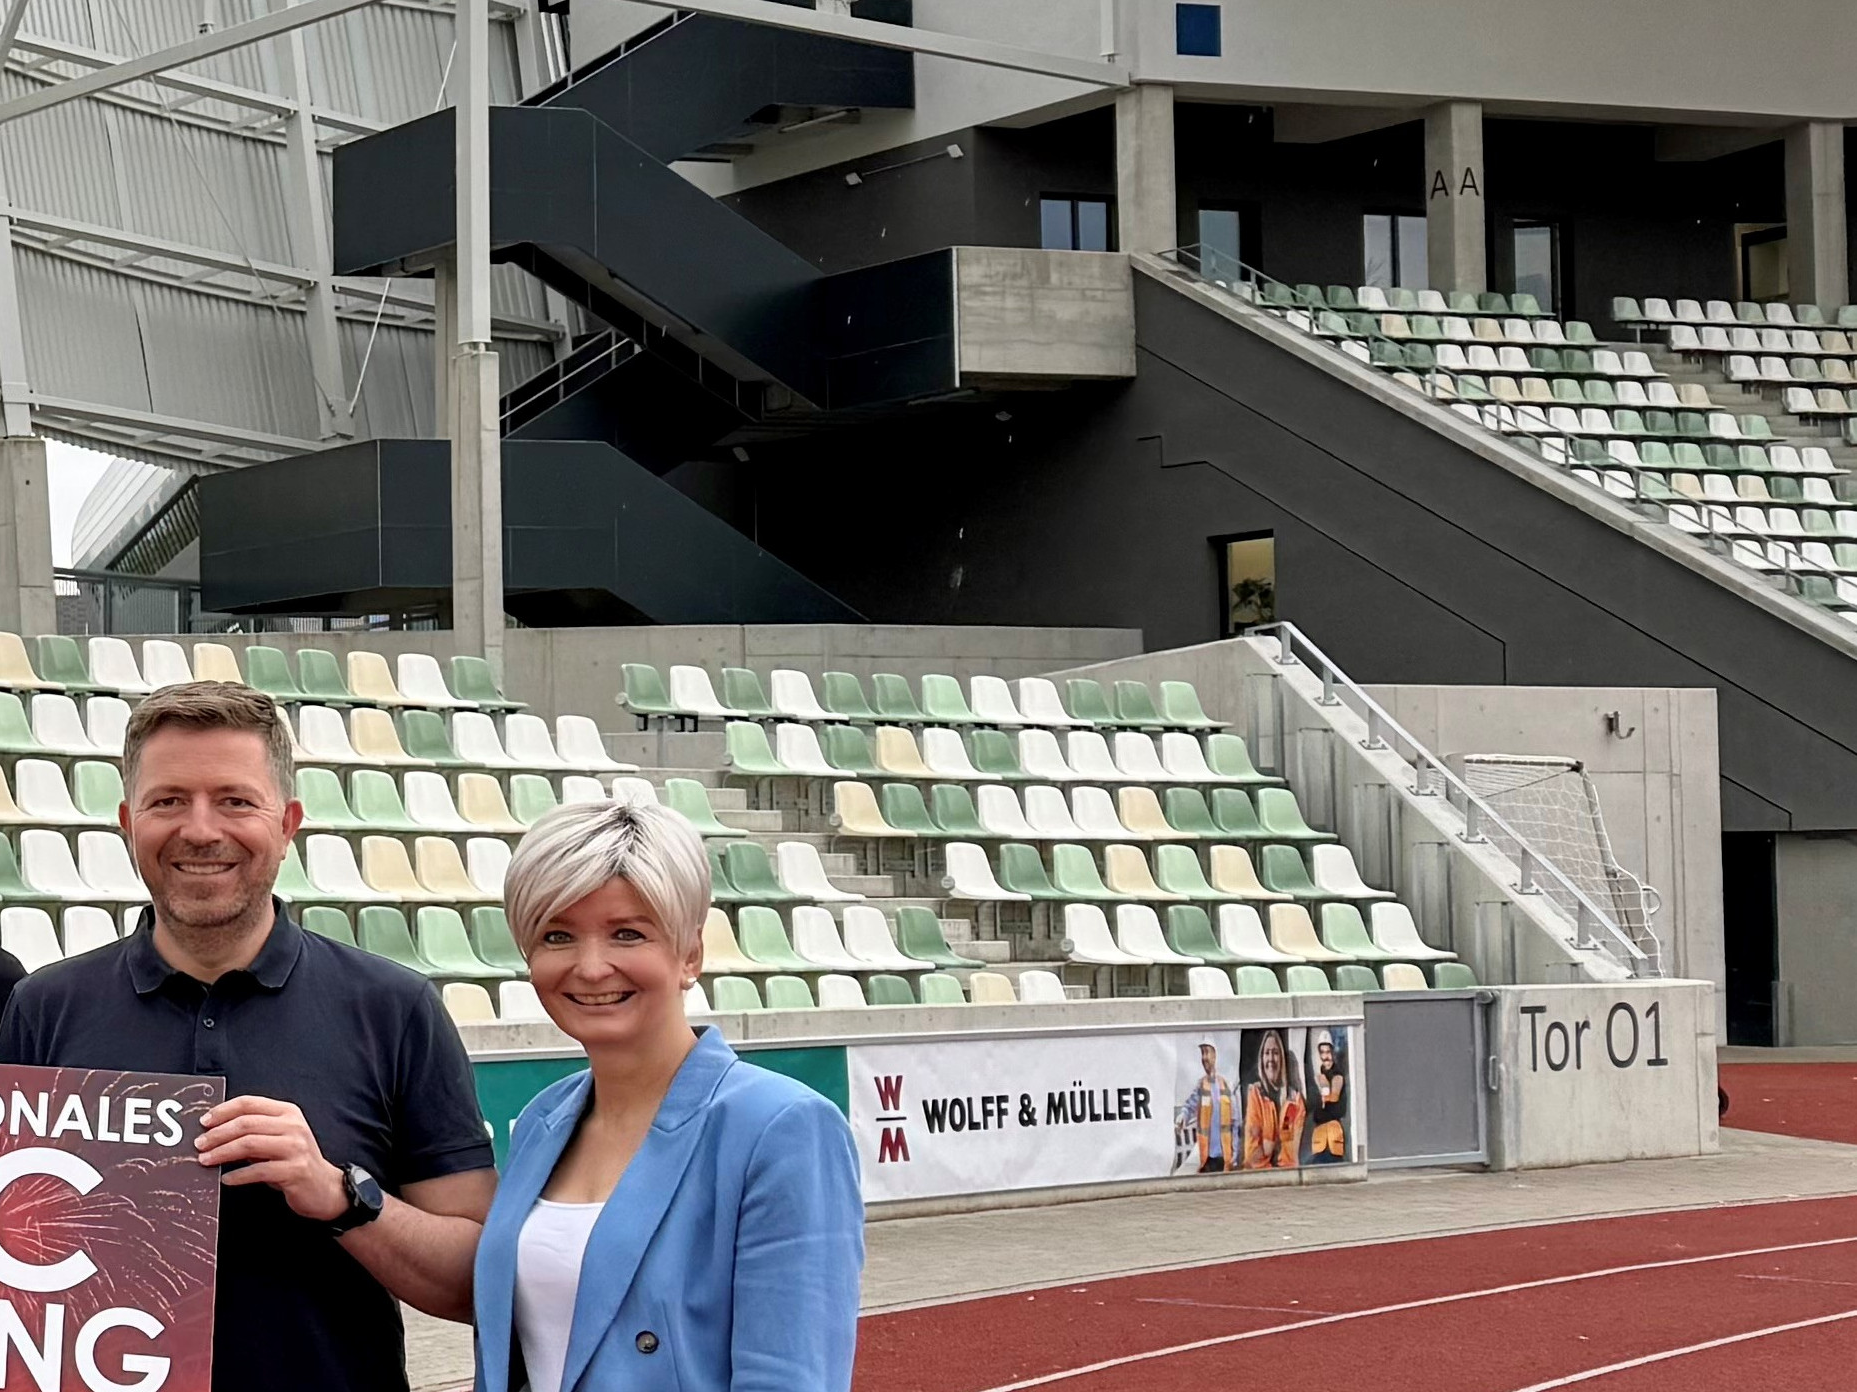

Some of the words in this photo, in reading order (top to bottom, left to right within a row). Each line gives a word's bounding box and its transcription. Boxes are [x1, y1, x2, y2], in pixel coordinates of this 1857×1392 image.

[1430, 169, 1449, 200] A
[1459, 166, 1479, 196] A
[1520, 1005, 1591, 1072] Tor
[922, 1095, 1009, 1134] WOLFF
[1018, 1093, 1038, 1127] &
[1046, 1080, 1152, 1126] MÜLLER
